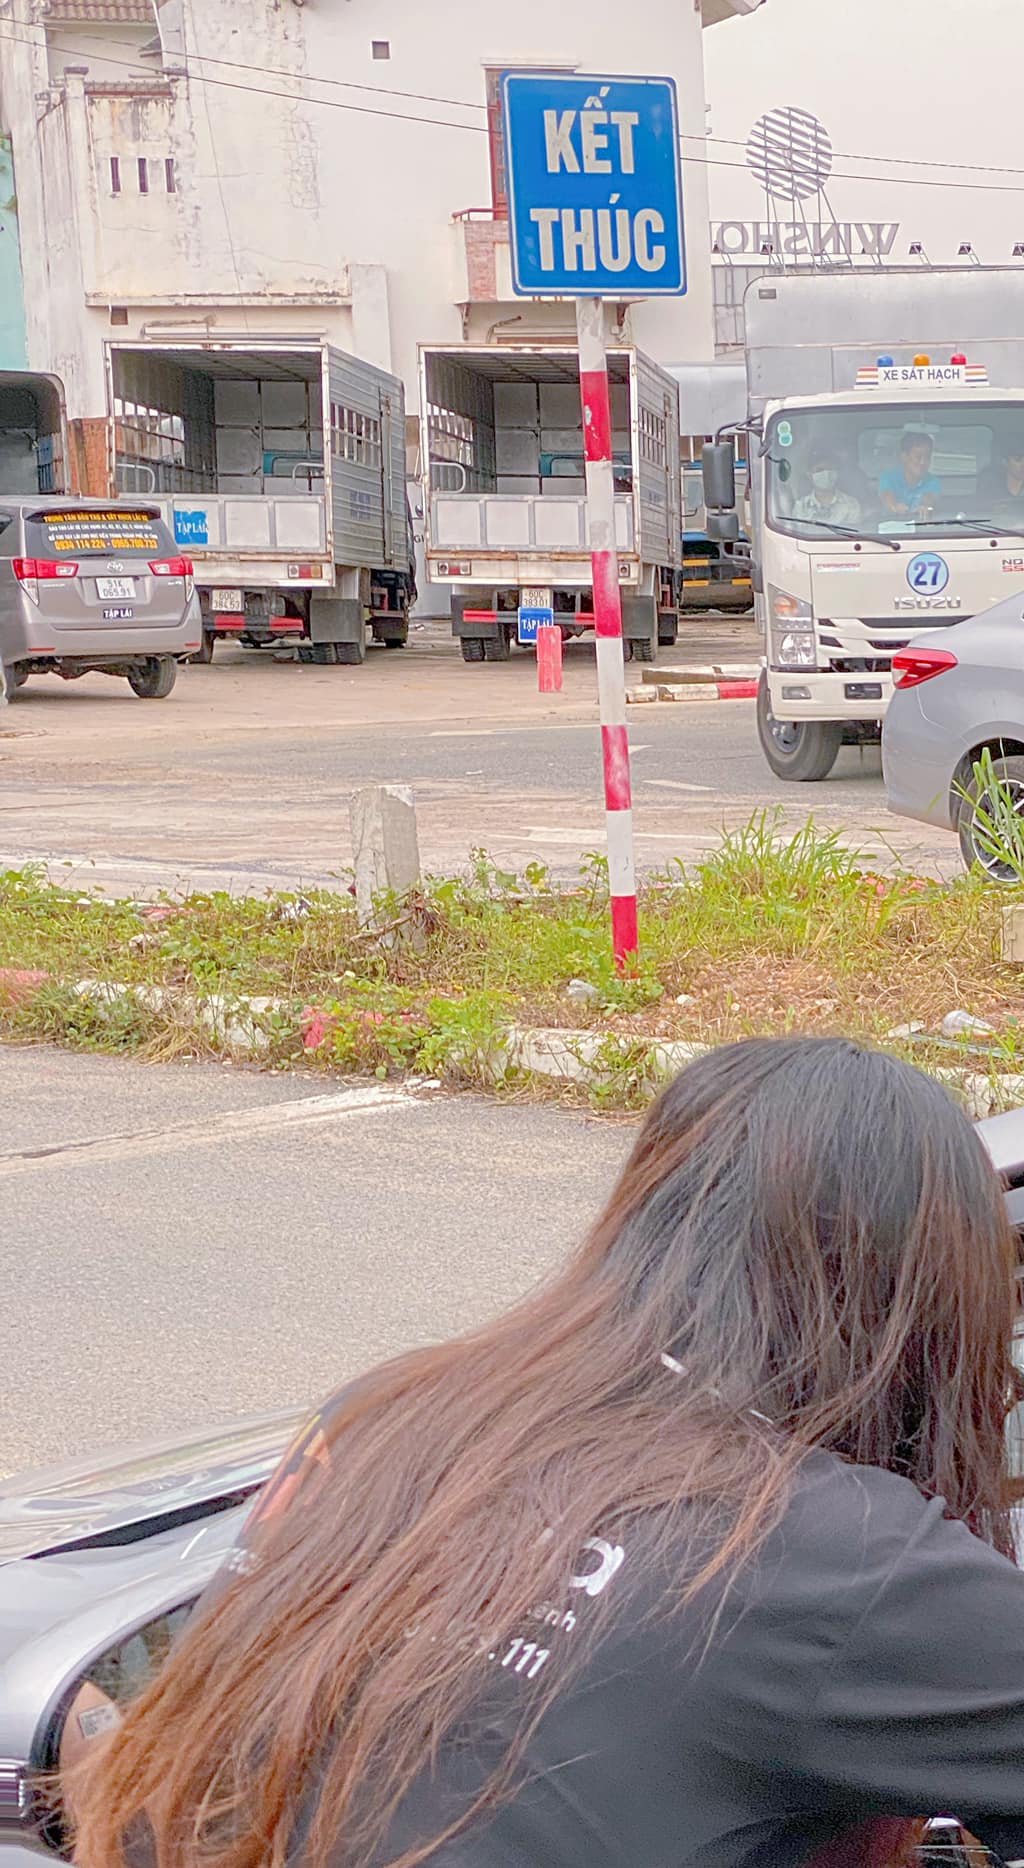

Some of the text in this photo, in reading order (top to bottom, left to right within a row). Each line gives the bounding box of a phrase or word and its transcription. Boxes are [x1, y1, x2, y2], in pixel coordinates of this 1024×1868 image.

[543, 86, 640, 175] KẾT
[529, 192, 667, 273] THÚC
[883, 367, 960, 384] XE SÁT HẠCH
[914, 561, 942, 586] 27
[894, 596, 961, 610] ISUZU
